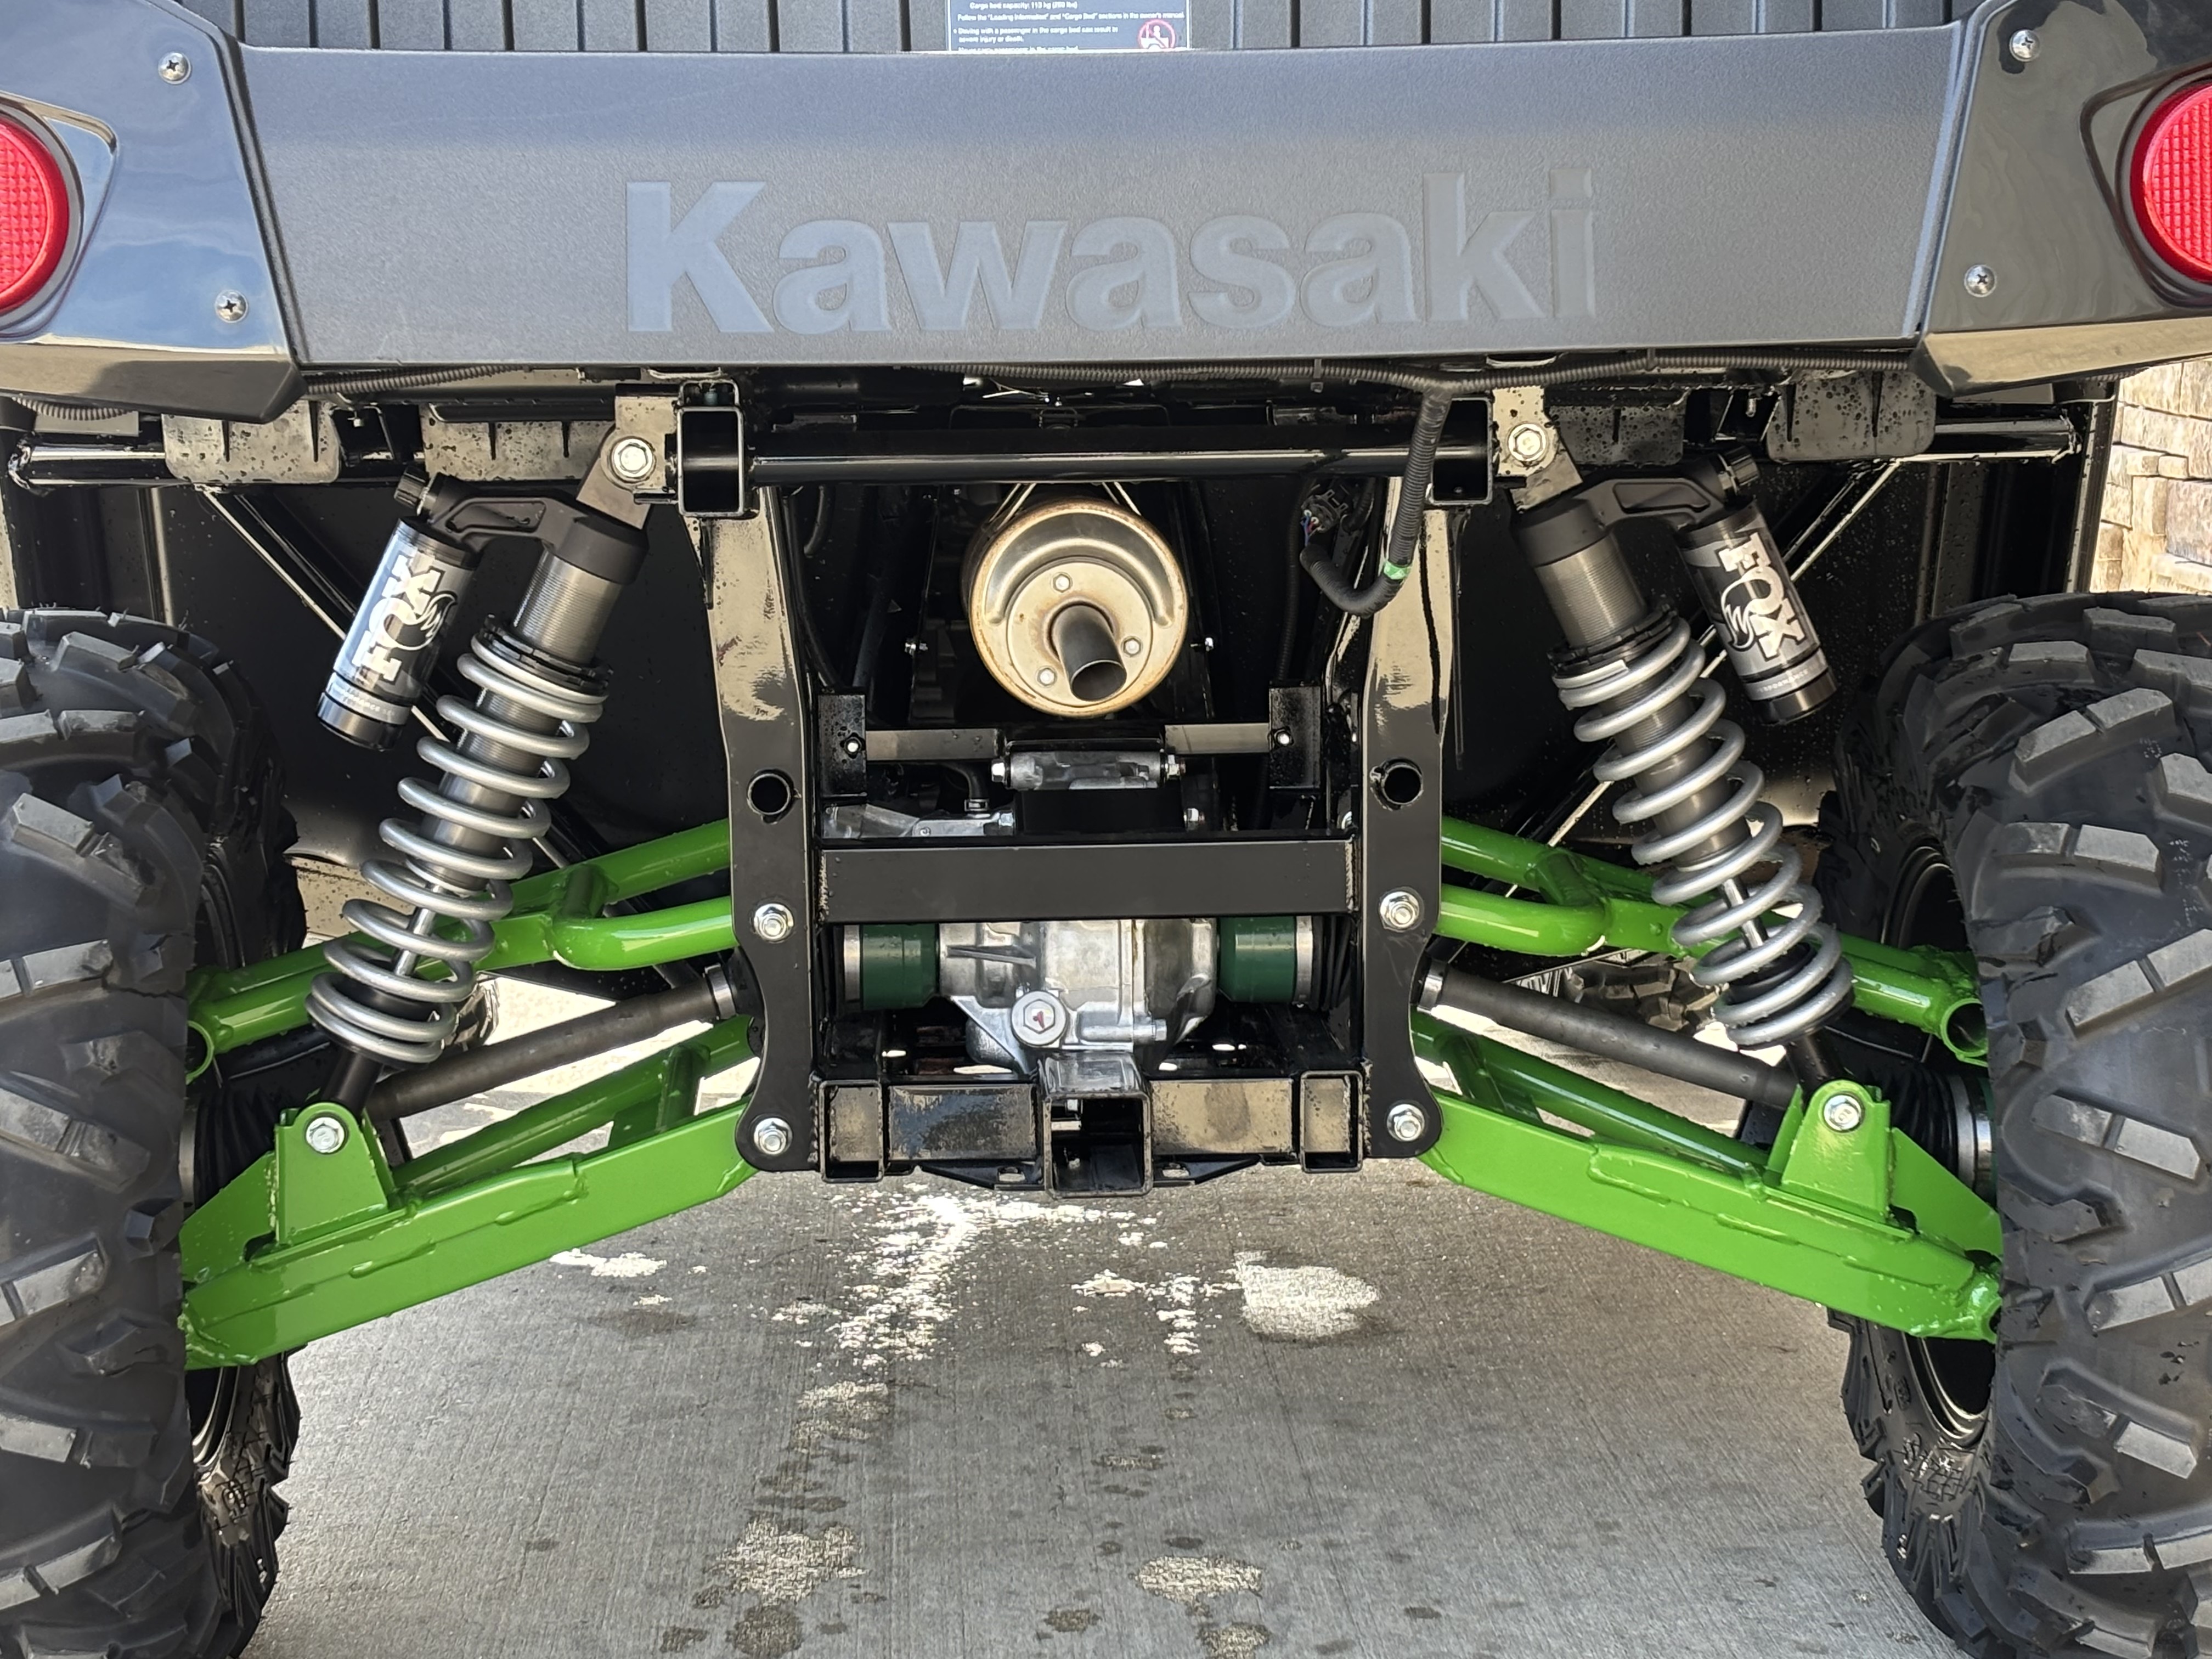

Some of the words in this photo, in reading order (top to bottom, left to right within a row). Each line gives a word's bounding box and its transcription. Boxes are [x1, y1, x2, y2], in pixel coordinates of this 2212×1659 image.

[969, 2, 988, 10] Cargo
[625, 167, 1596, 335] Kawasaki
[352, 554, 456, 682] FOX
[1718, 531, 1806, 658] FOX
